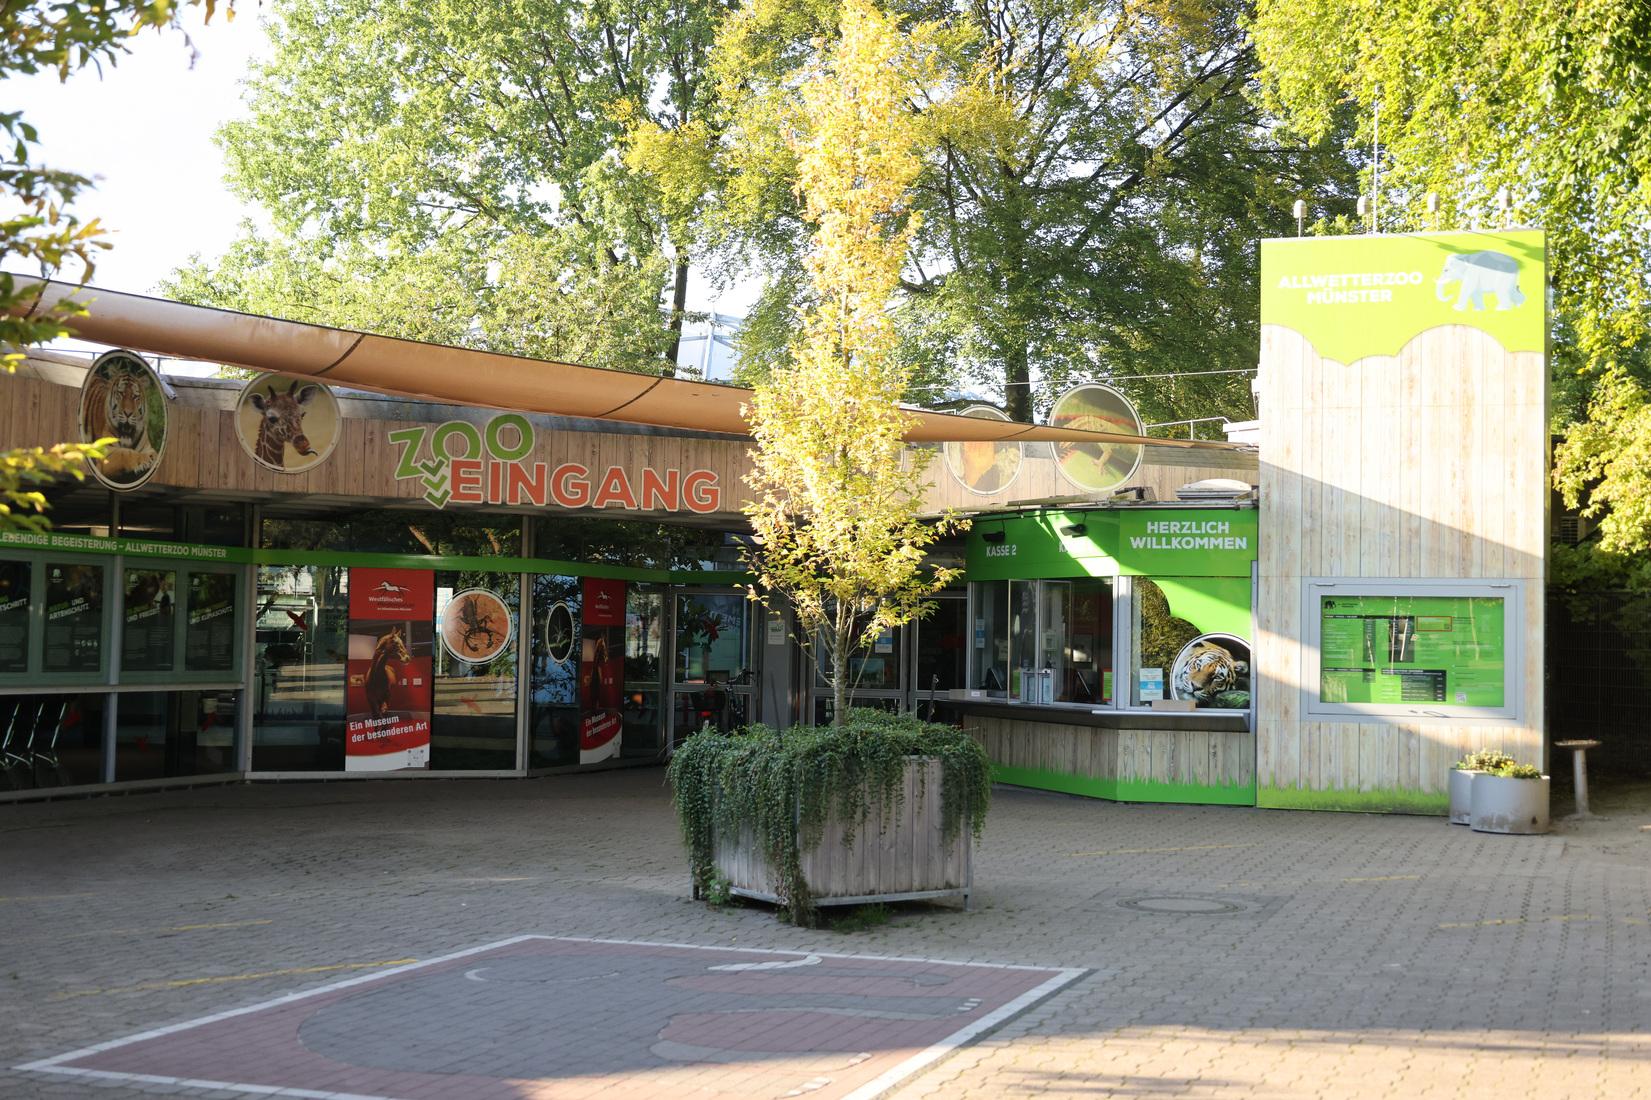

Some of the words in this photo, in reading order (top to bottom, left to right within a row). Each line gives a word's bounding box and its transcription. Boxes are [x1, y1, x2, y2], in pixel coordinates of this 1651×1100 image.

[1278, 271, 1424, 289] ALLWETTERZOO
[1306, 287, 1393, 305] MÜNSTER
[388, 412, 536, 480] ZOO
[449, 459, 722, 514] EINGANG
[1146, 521, 1230, 534] HERZLICH
[51, 535, 117, 552] BEGEISTERUNG
[125, 541, 189, 556] ALLWETTERZOO
[191, 544, 227, 558] MÜNSTER
[985, 545, 1010, 558] KASSE
[1010, 544, 1017, 557] 2
[1129, 536, 1248, 550] WILLKOMMEN
[349, 720, 363, 731] Ein
[364, 715, 400, 729] Museum
[351, 733, 365, 743] der
[367, 725, 414, 740] besonderen
[415, 721, 428, 732] Art
